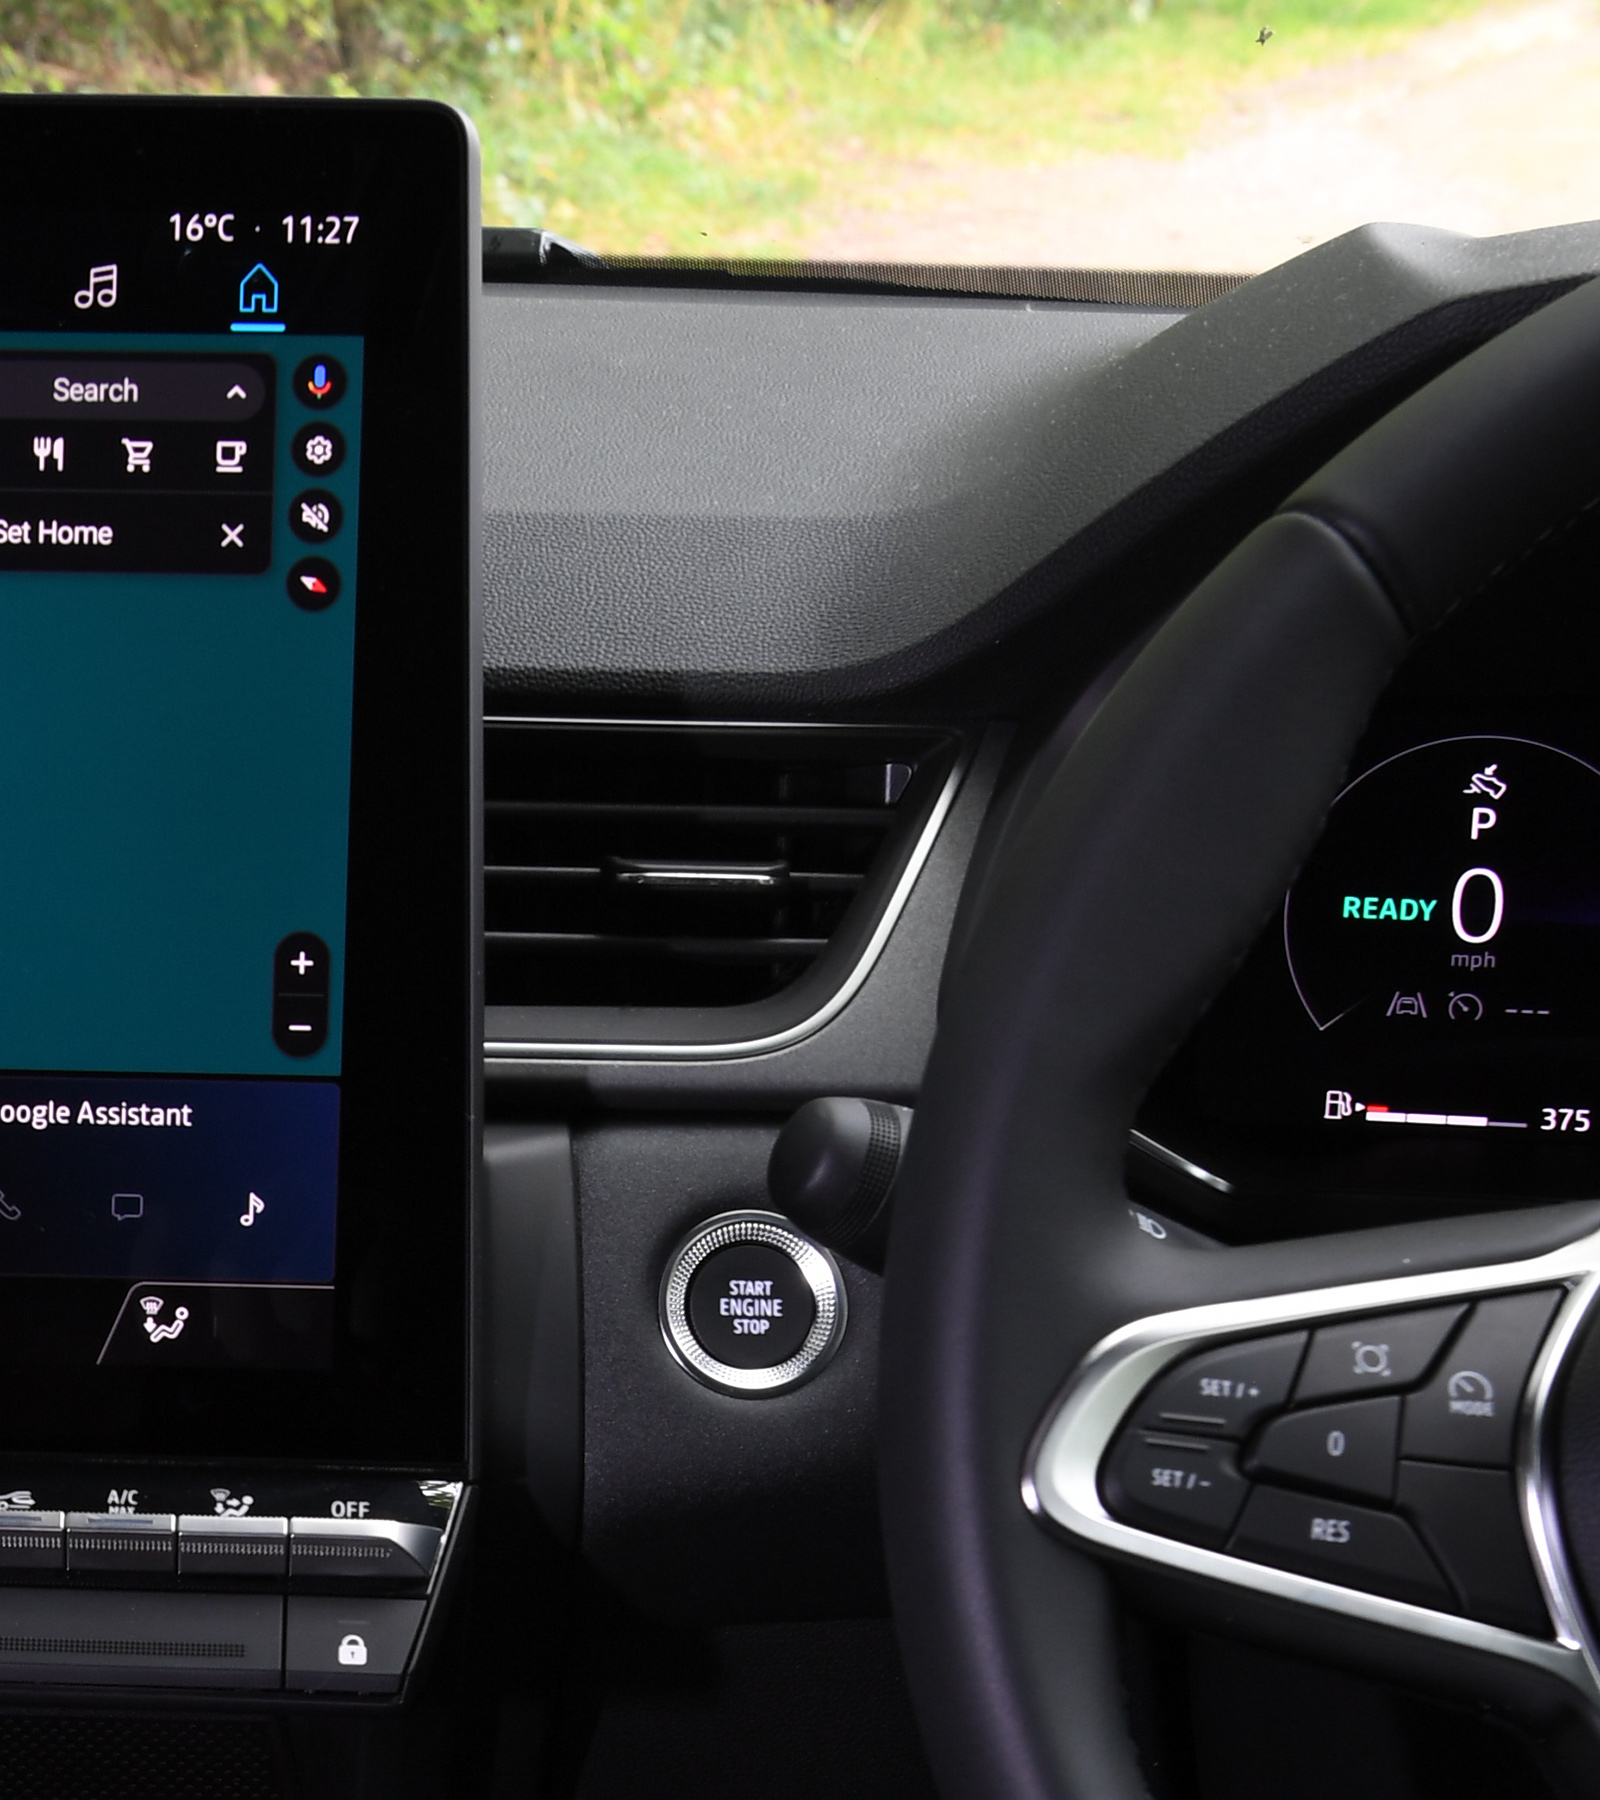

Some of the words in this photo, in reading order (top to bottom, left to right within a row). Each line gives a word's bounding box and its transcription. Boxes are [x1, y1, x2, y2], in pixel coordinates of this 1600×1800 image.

[169, 212, 235, 242] 16°C
[282, 214, 360, 245] 11:27
[53, 376, 139, 403] Search
[38, 519, 114, 546] Home
[1470, 806, 1497, 840] P
[1342, 895, 1438, 922] READY
[1451, 867, 1505, 944] 0
[1450, 950, 1497, 969] mph
[76, 1100, 193, 1128] Assistant
[1540, 1107, 1591, 1133] 375
[729, 1279, 774, 1296] START
[719, 1298, 783, 1317] ENGINE
[732, 1319, 770, 1335] STOP
[107, 1489, 139, 1506] A/C
[331, 1500, 371, 1518] OFF
[1310, 1517, 1350, 1544] RES
